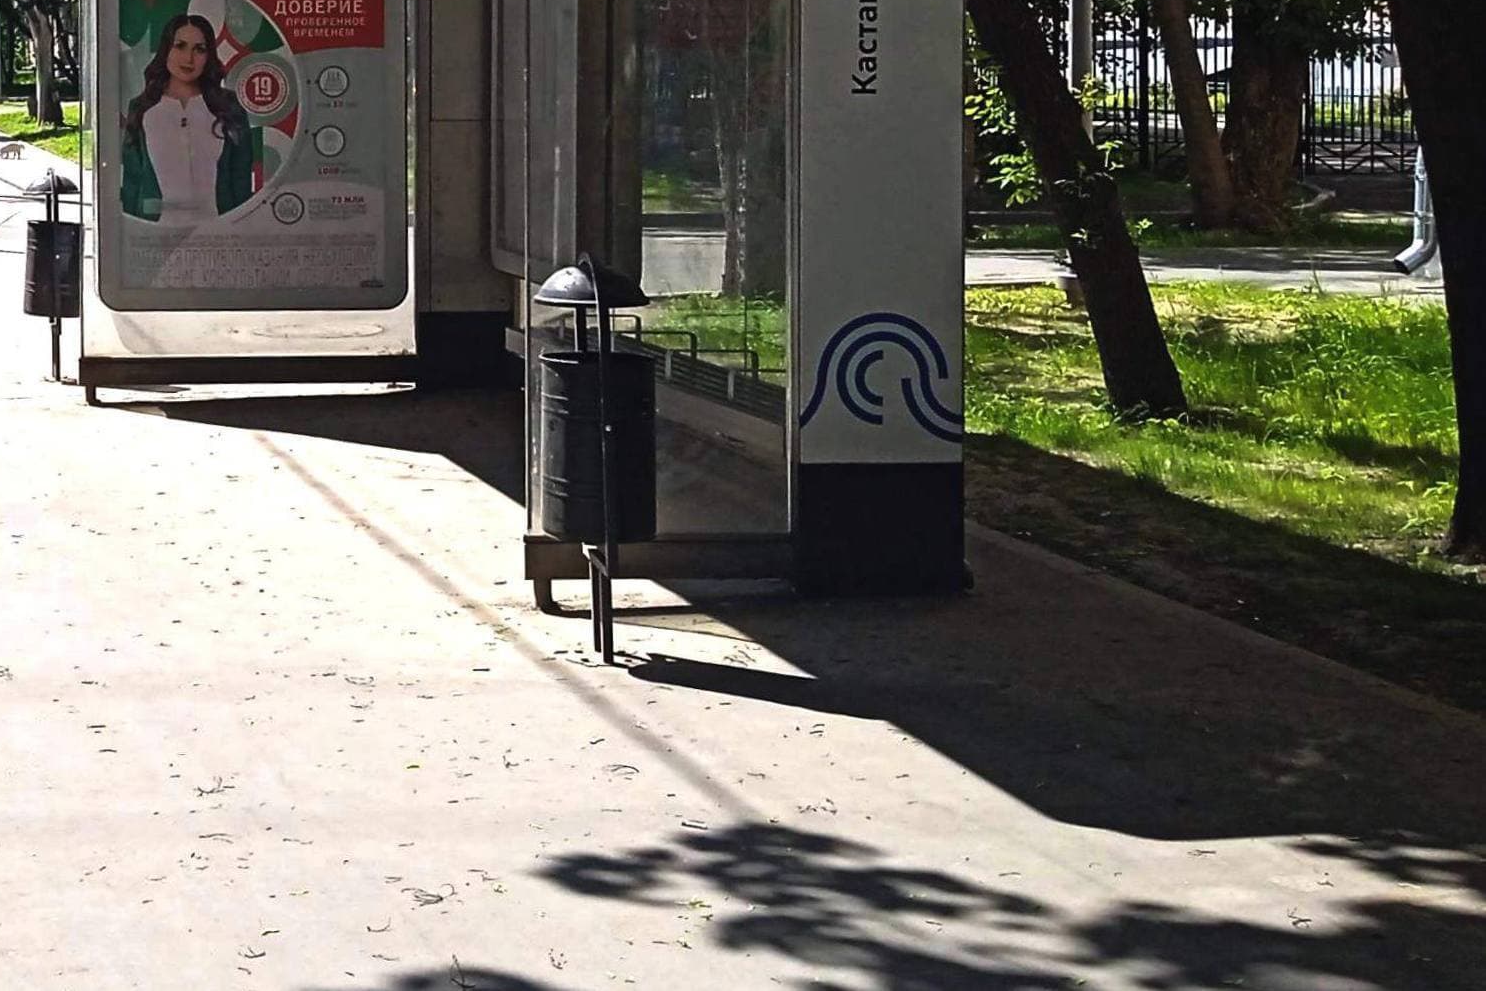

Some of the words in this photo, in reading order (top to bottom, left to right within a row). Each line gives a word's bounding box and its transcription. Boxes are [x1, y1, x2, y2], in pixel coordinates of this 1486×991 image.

[285, 17, 366, 26] ПРОВЕРЕННОЕ
[293, 28, 355, 37] ВРЕМЕНЕМ
[251, 76, 272, 96] 19
